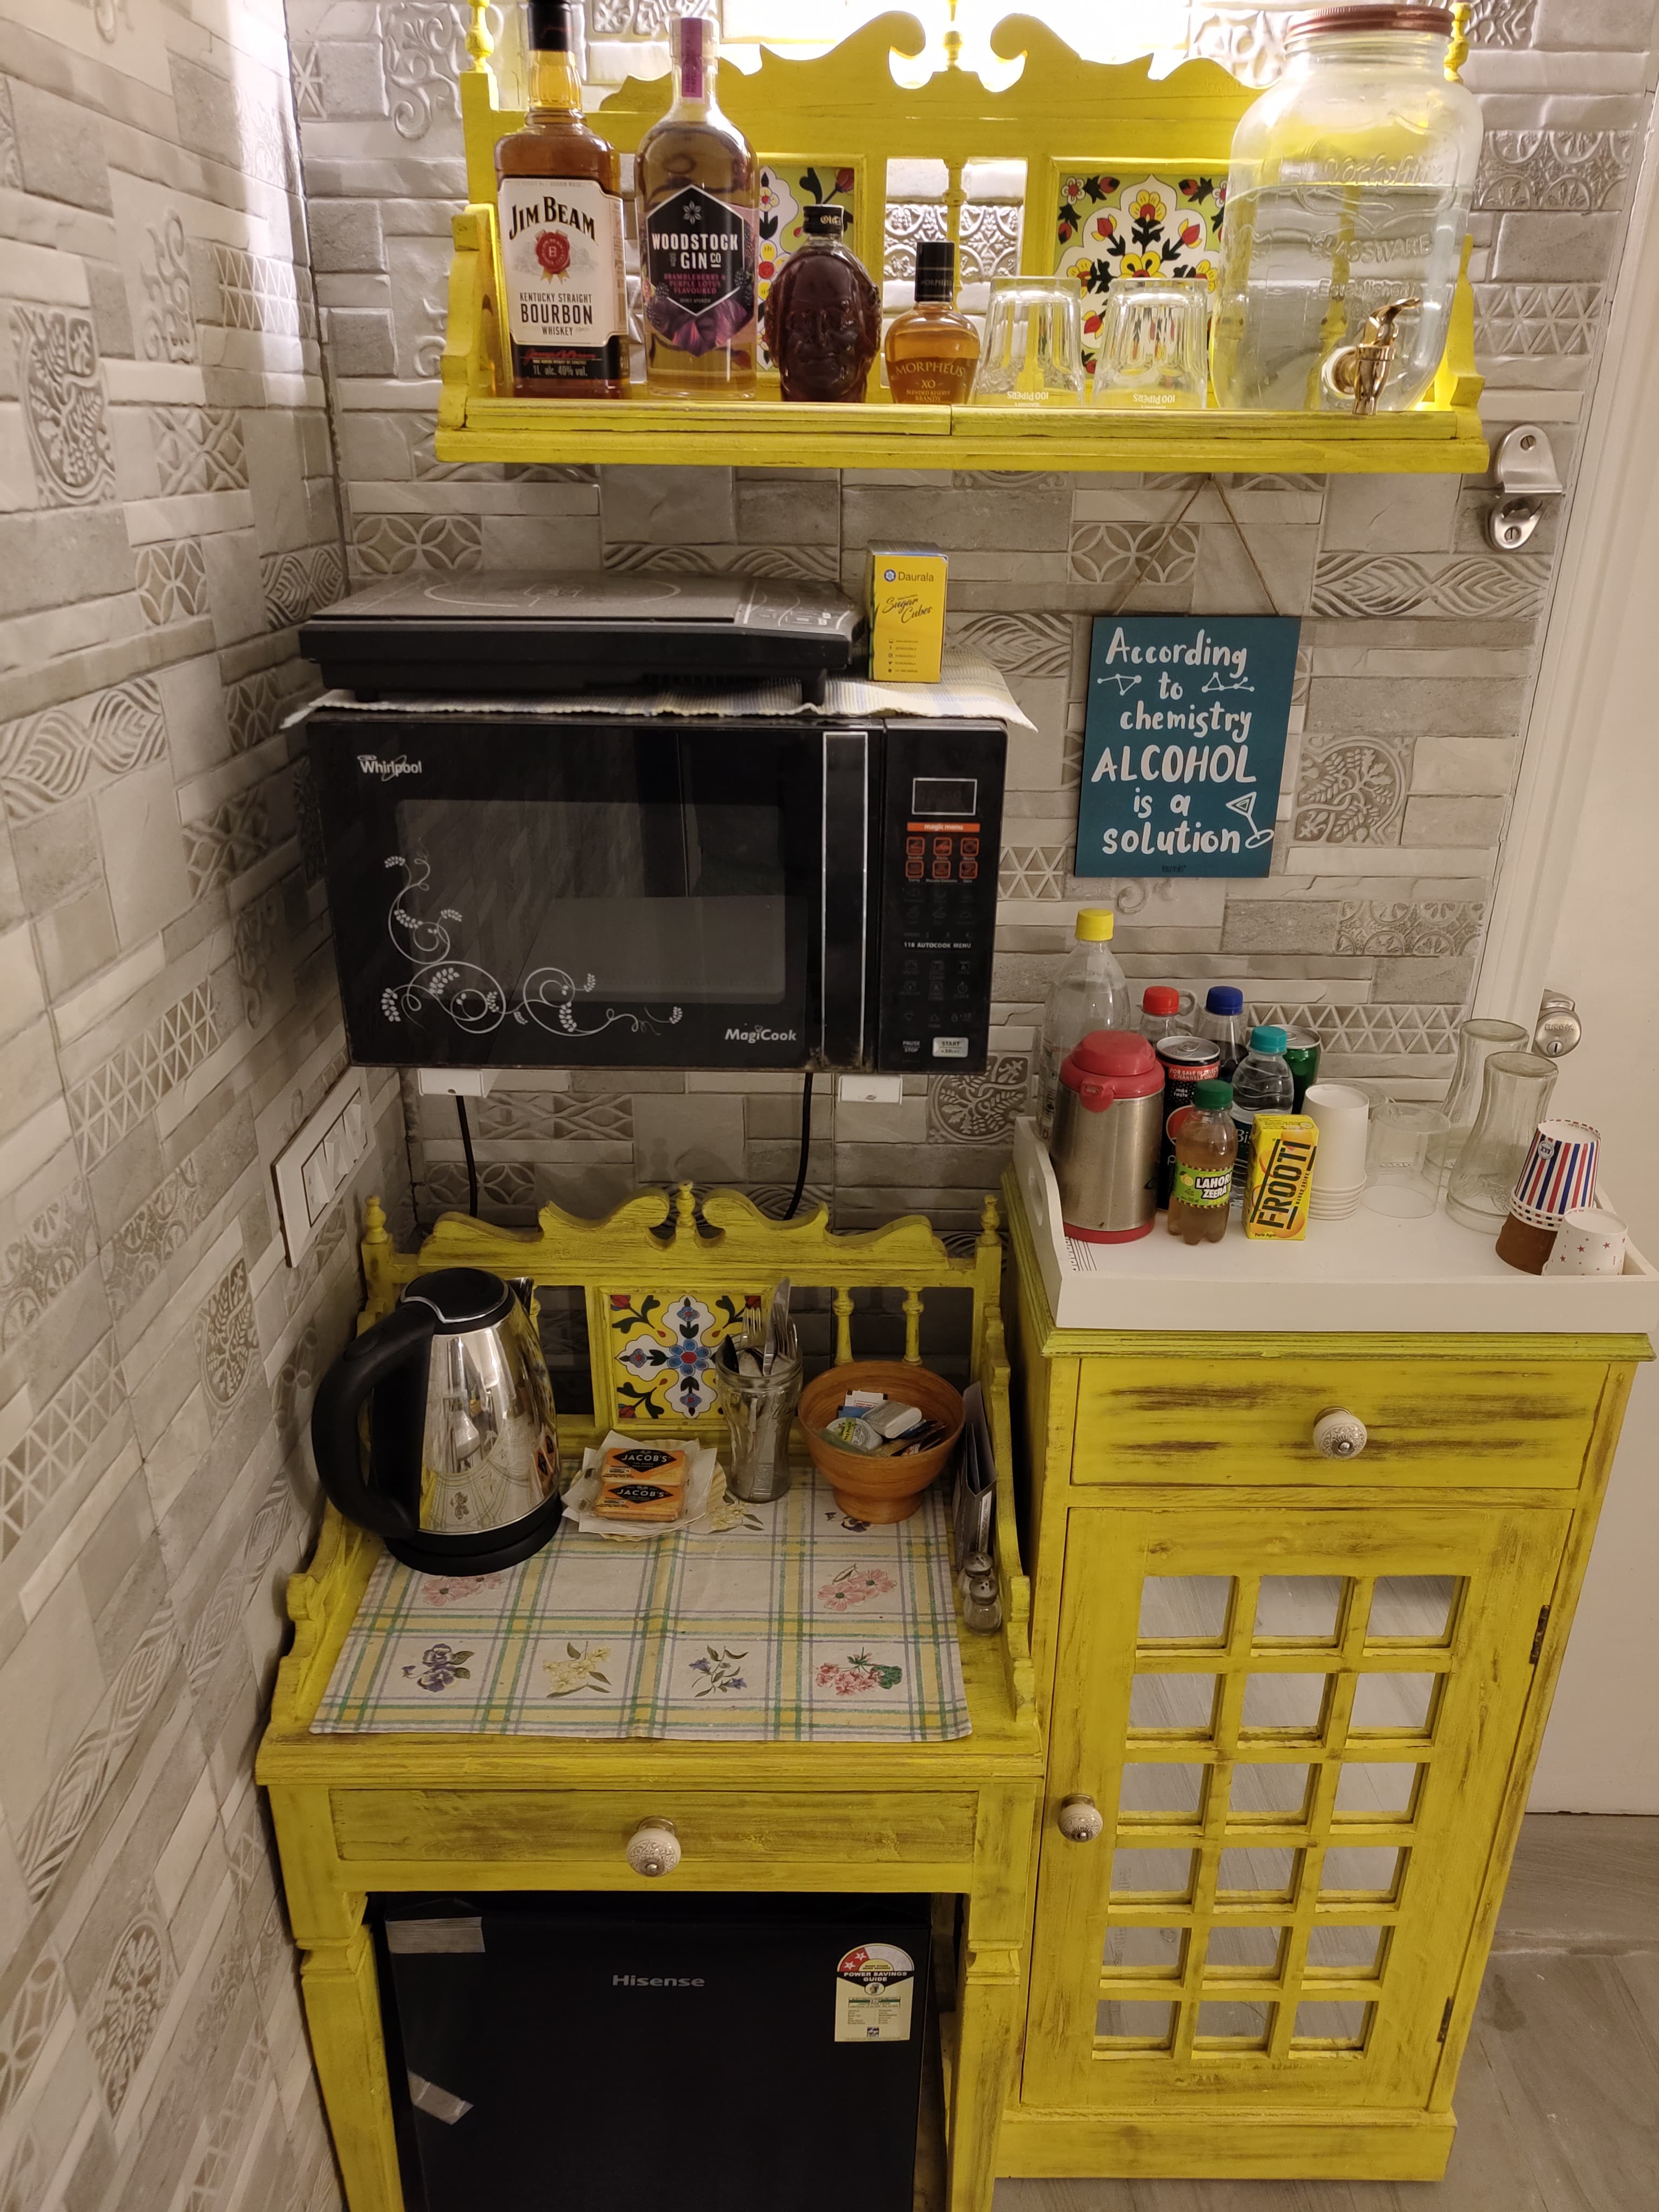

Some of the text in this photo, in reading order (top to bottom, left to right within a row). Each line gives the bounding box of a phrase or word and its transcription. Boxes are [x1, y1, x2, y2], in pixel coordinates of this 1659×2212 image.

[509, 196, 596, 242] JIM BEAM
[652, 233, 738, 251] WOODSTOCK
[680, 252, 707, 269] GIN
[710, 253, 721, 264] CO
[520, 292, 592, 303] KENTUCKY STRAIGHT
[521, 304, 593, 325] BOURBON
[542, 326, 573, 335] WHISKEY
[895, 361, 965, 377] MORPHEUS
[921, 380, 936, 389] XO
[1007, 391, 1034, 400] PIPERS
[1133, 394, 1176, 403] 100 PIPERS
[899, 572, 934, 582] Daurala
[882, 596, 919, 614] Sugar
[901, 604, 933, 623] Cubes
[1105, 626, 1247, 678] According
[1158, 671, 1183, 700] to
[1120, 700, 1252, 743] chemistry
[358, 757, 422, 779] Whirlpool
[1091, 745, 1256, 784] ALCOHOL
[1134, 787, 1191, 819] is a
[1102, 820, 1240, 854] solution
[725, 1028, 797, 1043] MagiCook
[1202, 1186, 1227, 1198] ZEERA
[1256, 1141, 1311, 1229] FROOTI
[622, 1454, 668, 1462] JACOB'S
[617, 1489, 665, 1498] JACOB'S
[612, 1974, 705, 1987] Hisense
